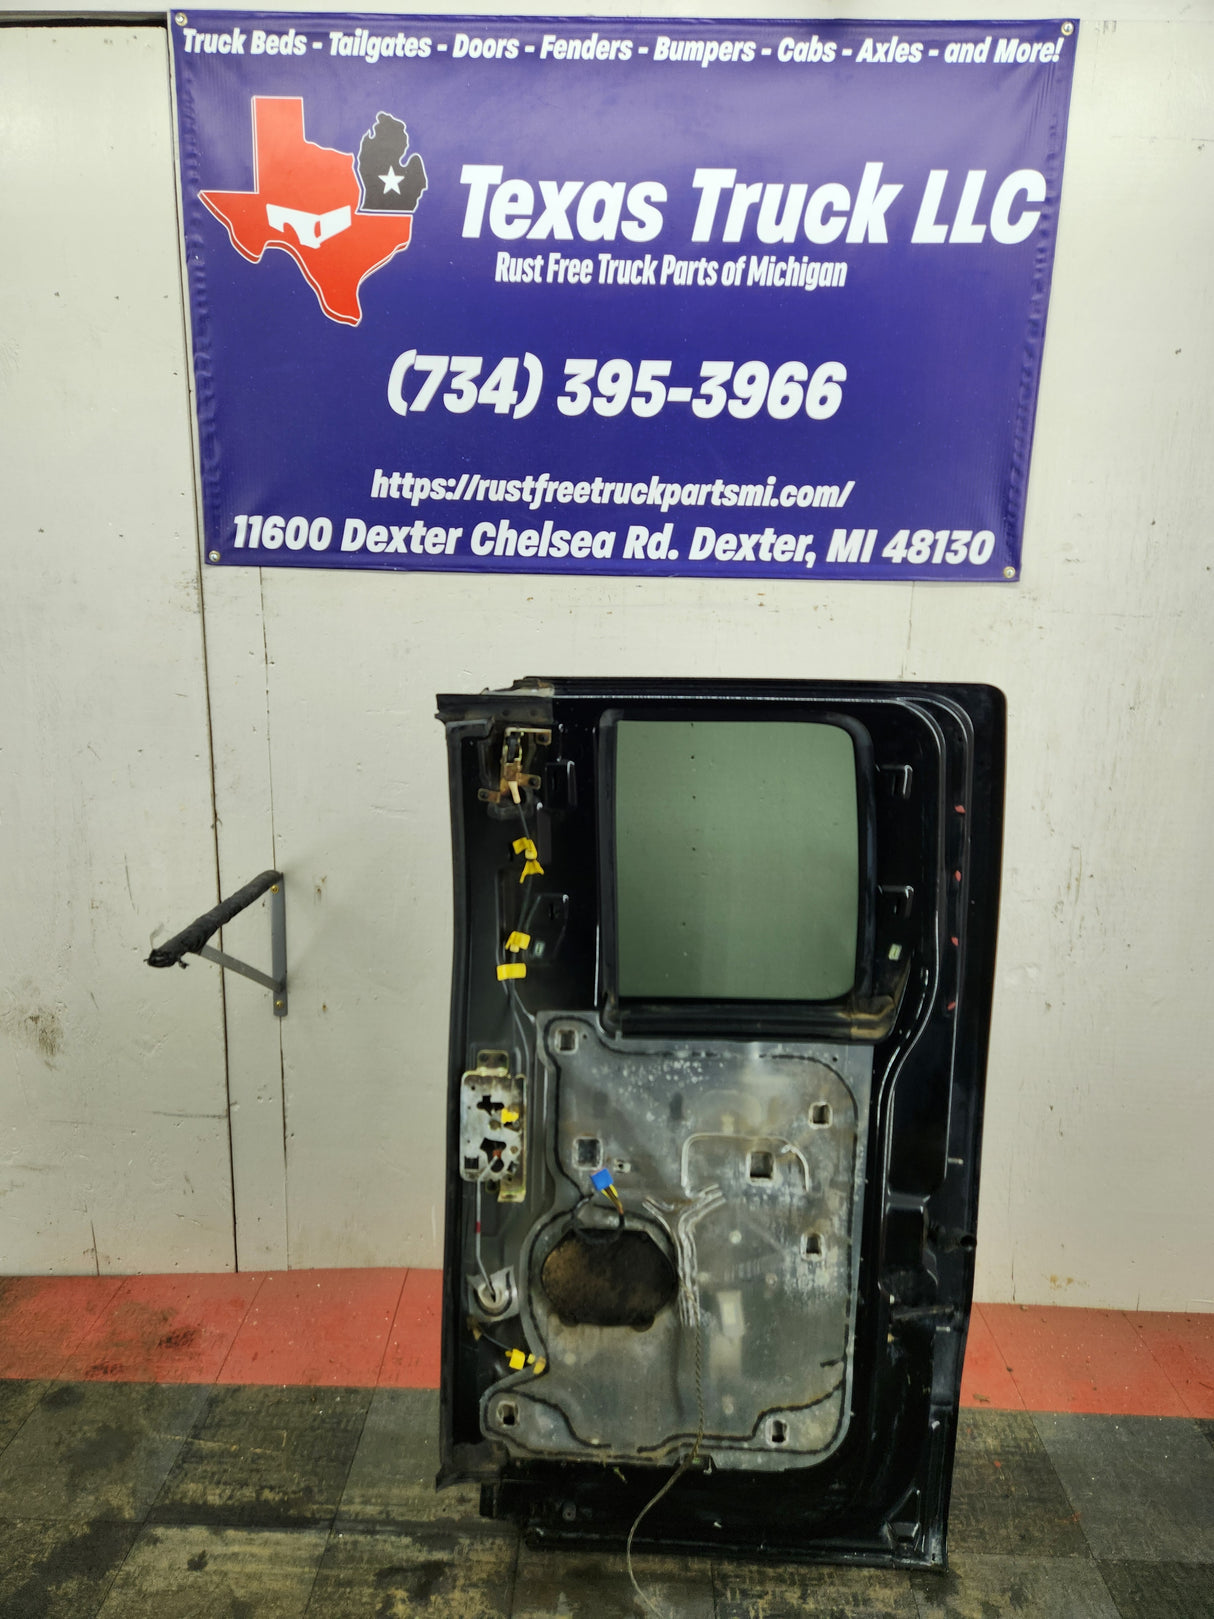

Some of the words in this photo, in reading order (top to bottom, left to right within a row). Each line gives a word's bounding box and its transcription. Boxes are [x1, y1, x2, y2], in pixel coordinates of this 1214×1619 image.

[182, 28, 247, 55] Truck
[250, 29, 307, 56] Beds
[329, 28, 433, 64] Tailgates
[452, 33, 520, 59] Doors
[539, 33, 634, 61] Fenders
[653, 36, 757, 69] Bumpers
[777, 35, 838, 63] Cabs
[855, 36, 924, 64] Axles
[943, 36, 993, 64] and
[992, 37, 1065, 64] More!
[459, 163, 668, 245] Texas
[691, 161, 905, 245] Truck
[910, 167, 1047, 246] LLC
[494, 251, 544, 283] Rust
[546, 252, 594, 285] Free
[598, 253, 659, 286] Truck
[659, 254, 719, 287] Parts
[720, 255, 747, 287] of
[746, 255, 848, 292] Michigan
[387, 349, 544, 420] (734)
[556, 358, 847, 420] 395-3966
[370, 468, 856, 513] https://rustfreetruckpartsmi.com/
[233, 514, 333, 552] 11600
[340, 518, 463, 556] Dexter
[470, 519, 617, 560] Chelsea
[622, 521, 679, 561] Rd.
[688, 526, 817, 569] Dexter,
[825, 528, 879, 564] MI
[881, 528, 996, 566] 48130
